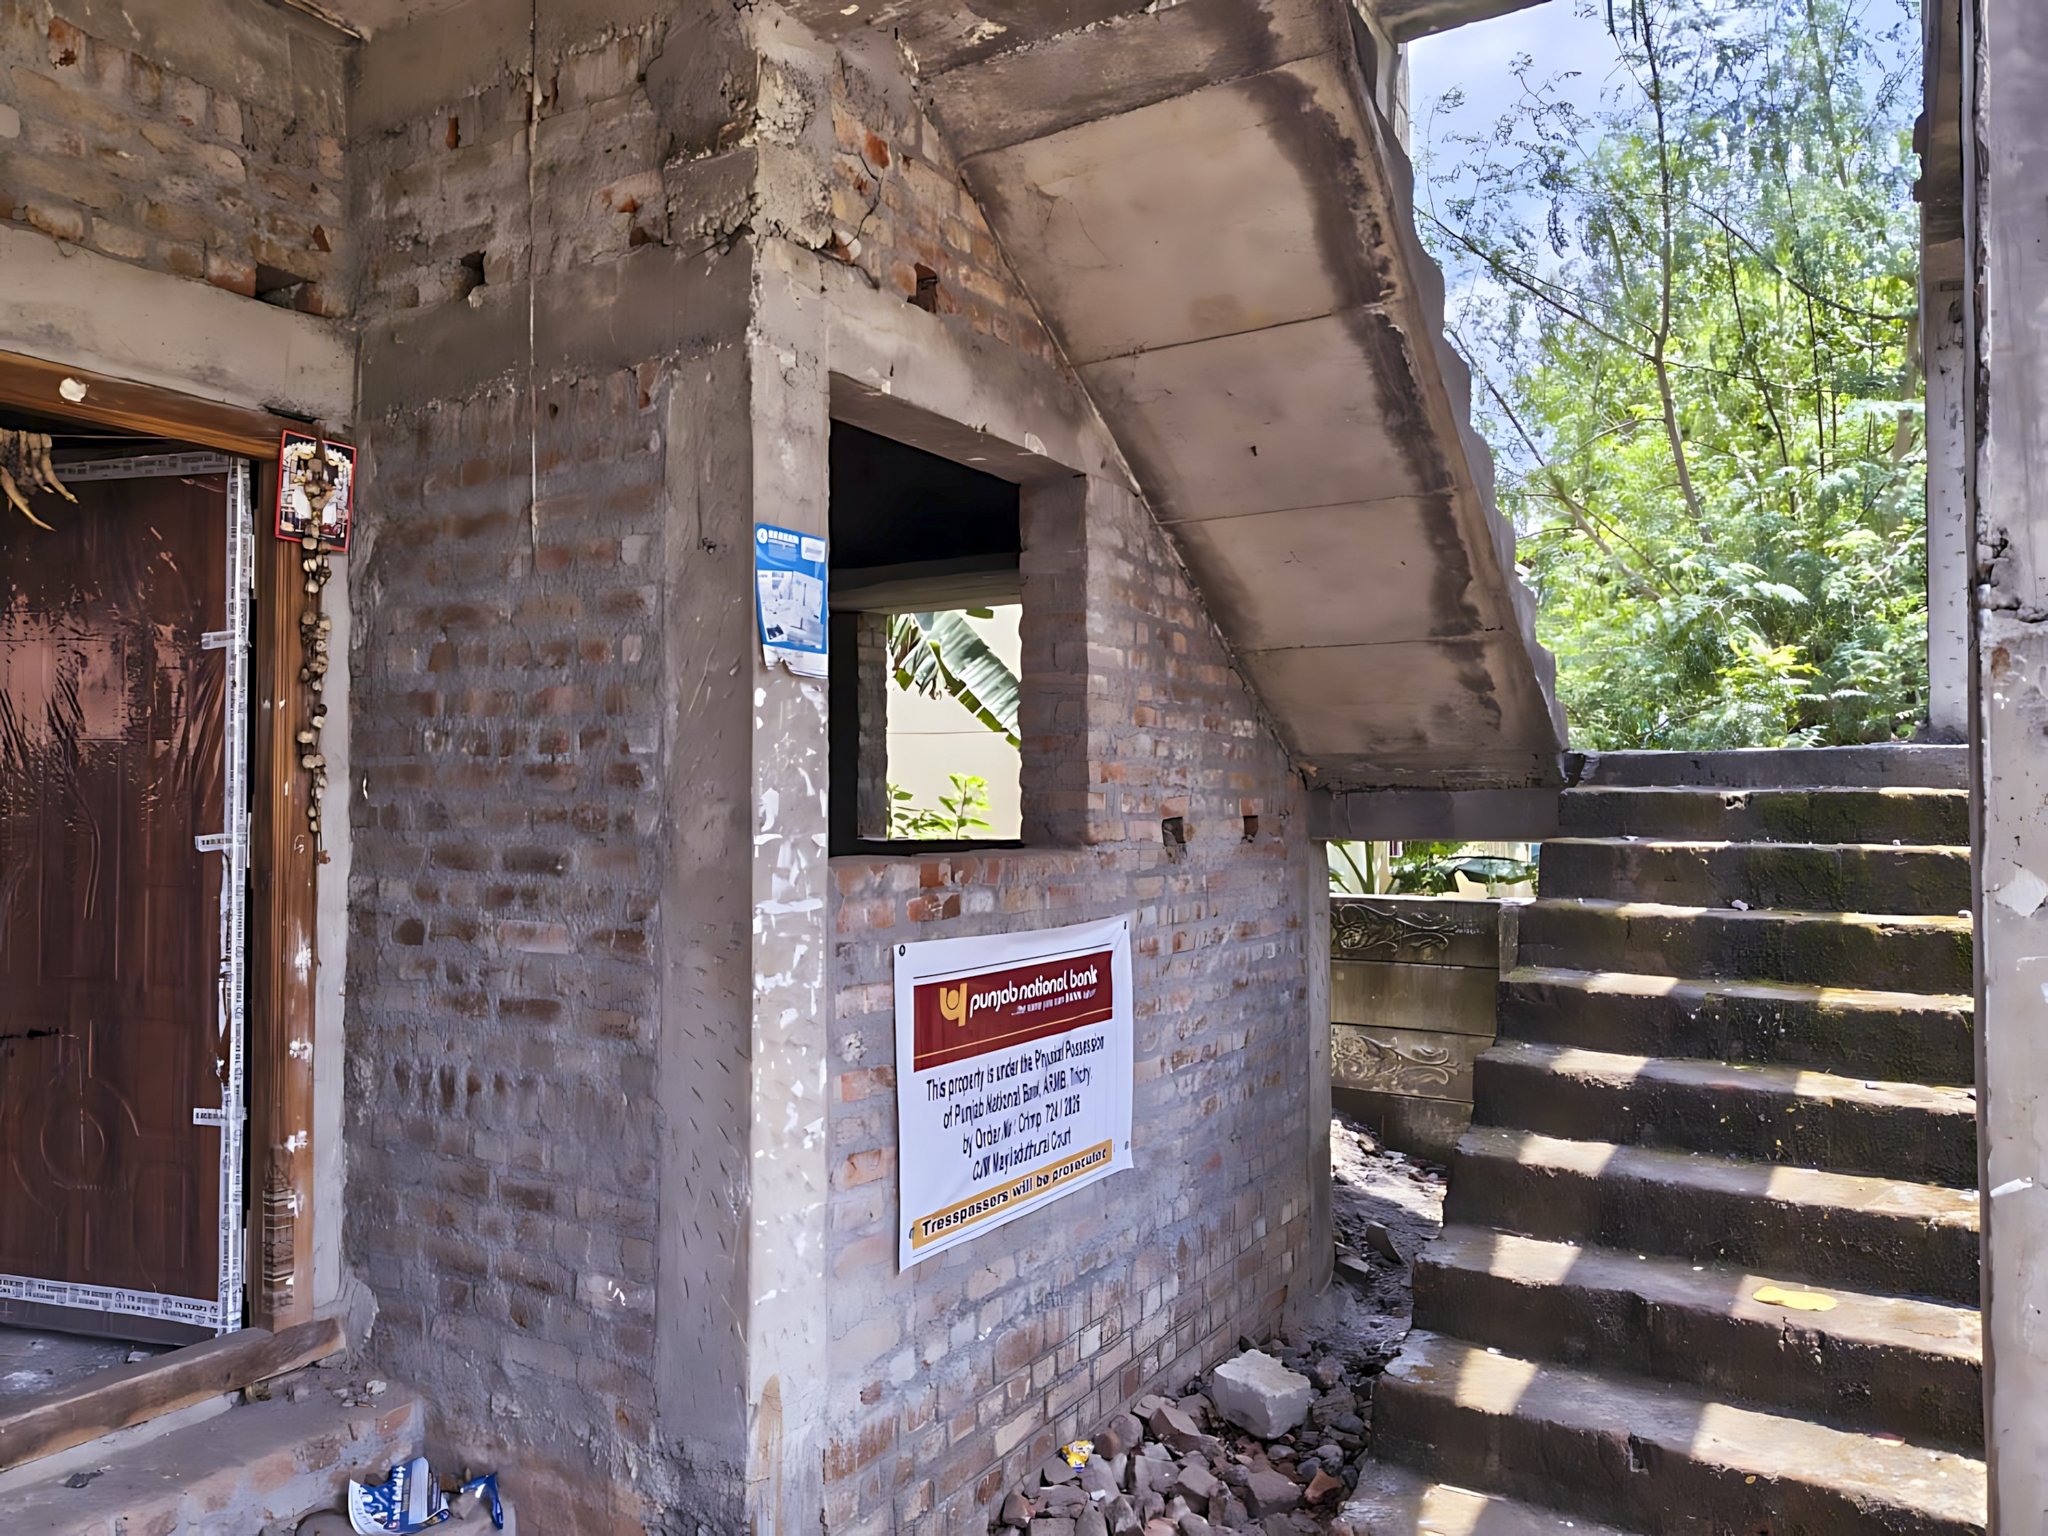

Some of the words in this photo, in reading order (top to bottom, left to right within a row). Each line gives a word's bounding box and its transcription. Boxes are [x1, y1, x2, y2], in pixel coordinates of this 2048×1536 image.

[969, 980, 1018, 1018] punjab
[1019, 974, 1068, 1000] national
[1070, 964, 1098, 989] bank
[926, 1077, 946, 1101] This
[948, 1067, 984, 1101] property
[987, 1064, 994, 1083] is
[996, 1057, 1018, 1082] under
[1020, 1053, 1033, 1074] the
[943, 1105, 953, 1129] of
[955, 1096, 985, 1126] Punjab
[986, 1085, 1021, 1115] National
[963, 1133, 973, 1158] by
[976, 1124, 1001, 1149] Order
[1051, 1126, 1071, 1150] Court
[922, 1191, 1009, 1237] Tresspassers
[1012, 1177, 1033, 1197] will
[1036, 1174, 1050, 1188] be
